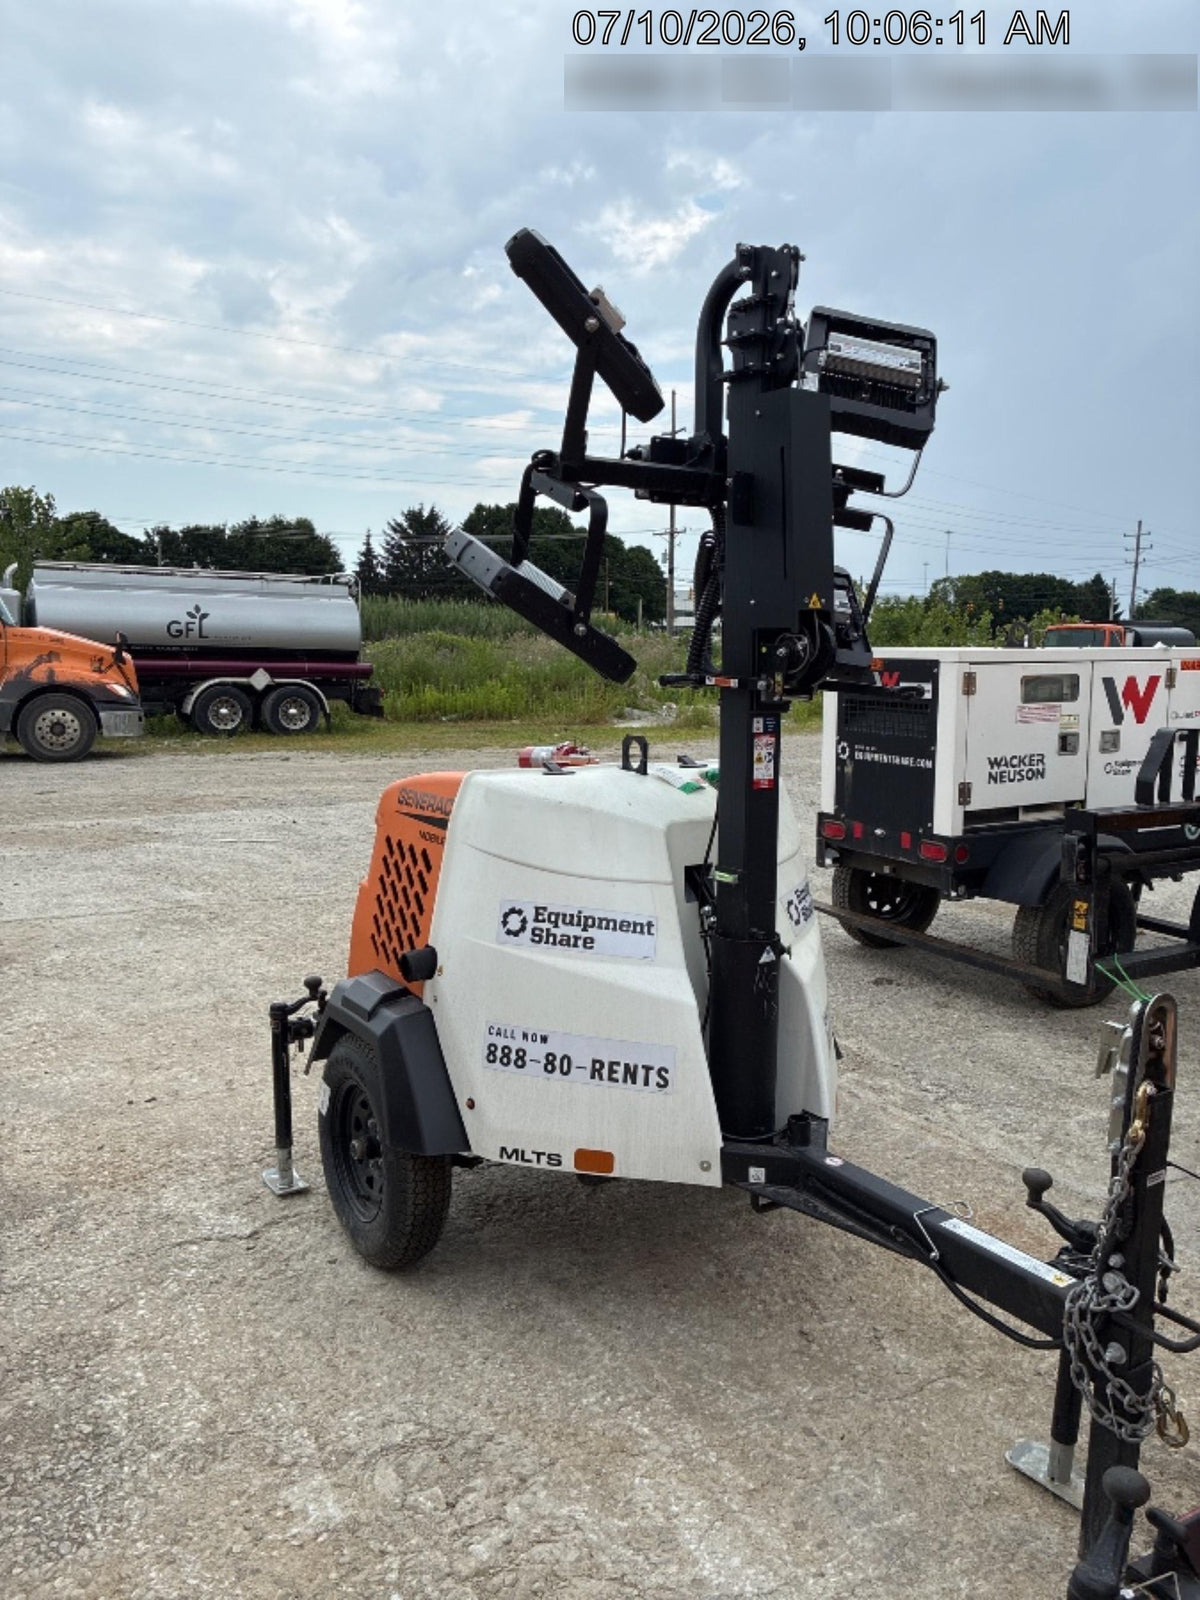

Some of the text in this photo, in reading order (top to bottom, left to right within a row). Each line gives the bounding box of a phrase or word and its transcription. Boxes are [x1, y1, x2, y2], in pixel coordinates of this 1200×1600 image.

[166, 617, 209, 639] GFL
[987, 753, 1046, 770] WACKER
[988, 767, 1046, 784] NEUSON
[532, 906, 656, 936] Equipment
[530, 927, 596, 950] Share
[488, 1025, 549, 1045] CALL NOW
[486, 1042, 671, 1090] 888-80-RENTS
[499, 1146, 563, 1167] MLTS
